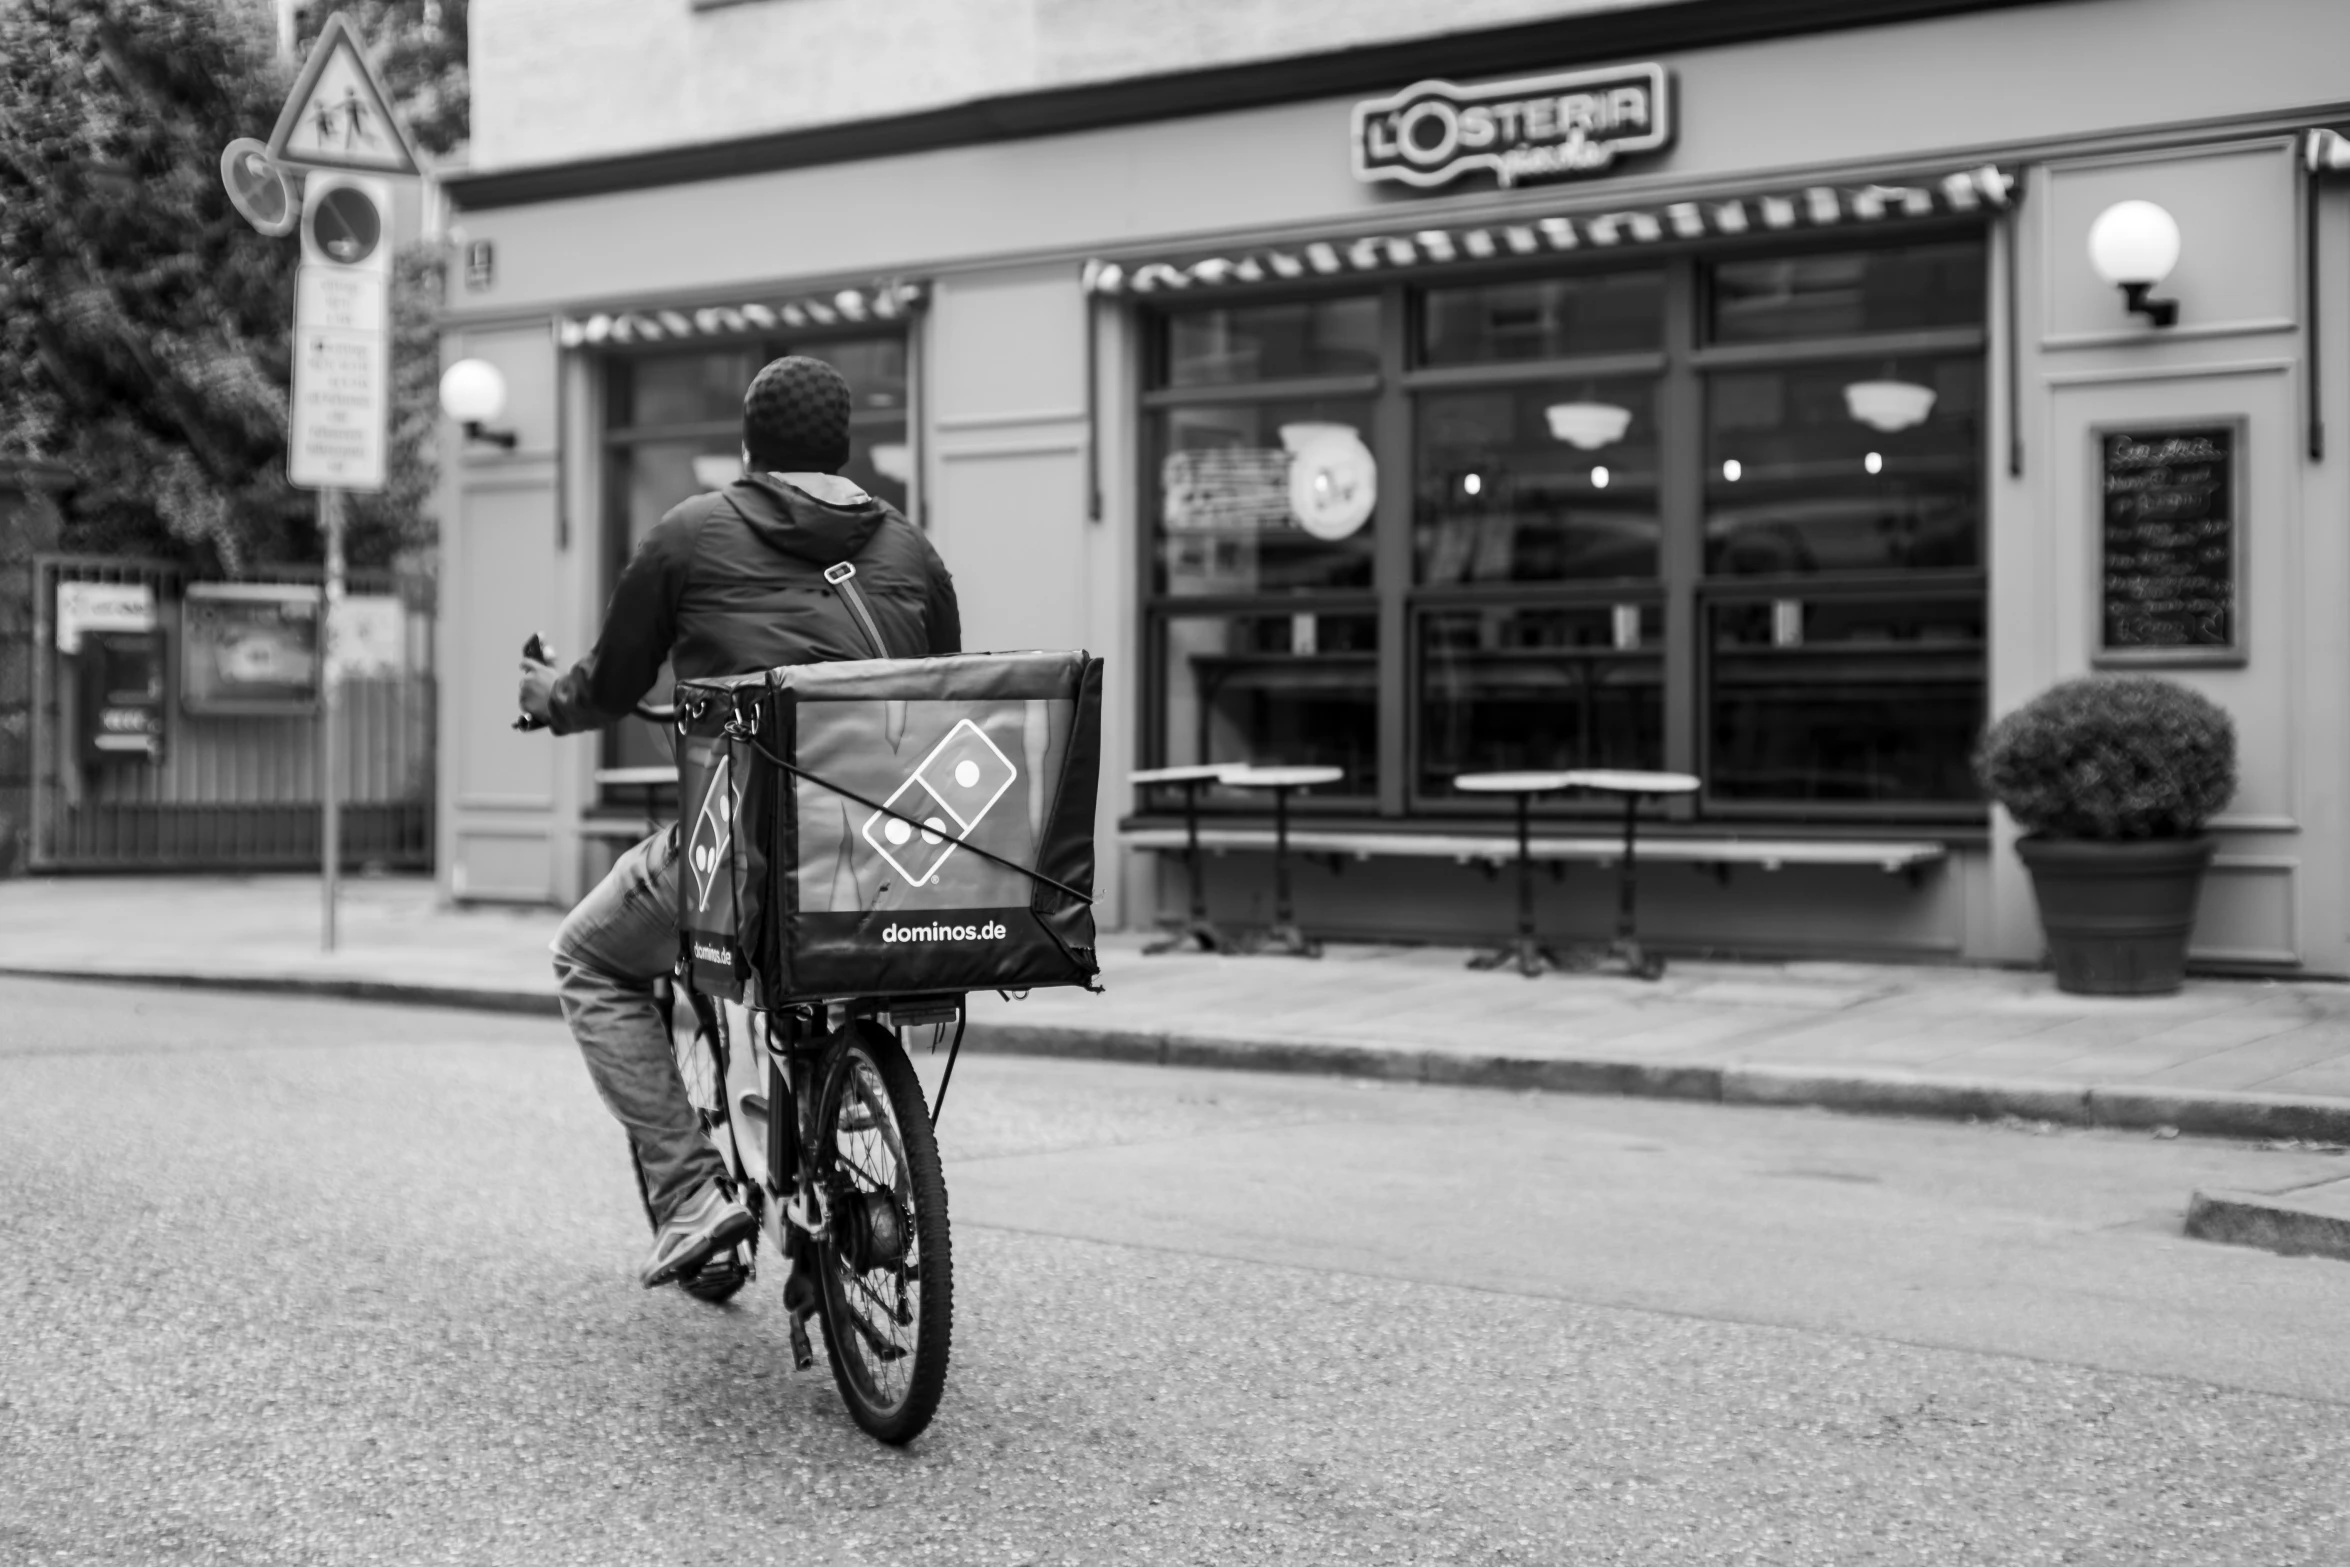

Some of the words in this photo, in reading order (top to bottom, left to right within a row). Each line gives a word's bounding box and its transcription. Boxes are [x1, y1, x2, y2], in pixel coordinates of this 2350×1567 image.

[1367, 86, 1648, 165] L'OSTERIA
[882, 920, 1006, 943] dominos.de
[694, 941, 732, 965] dominos.de
